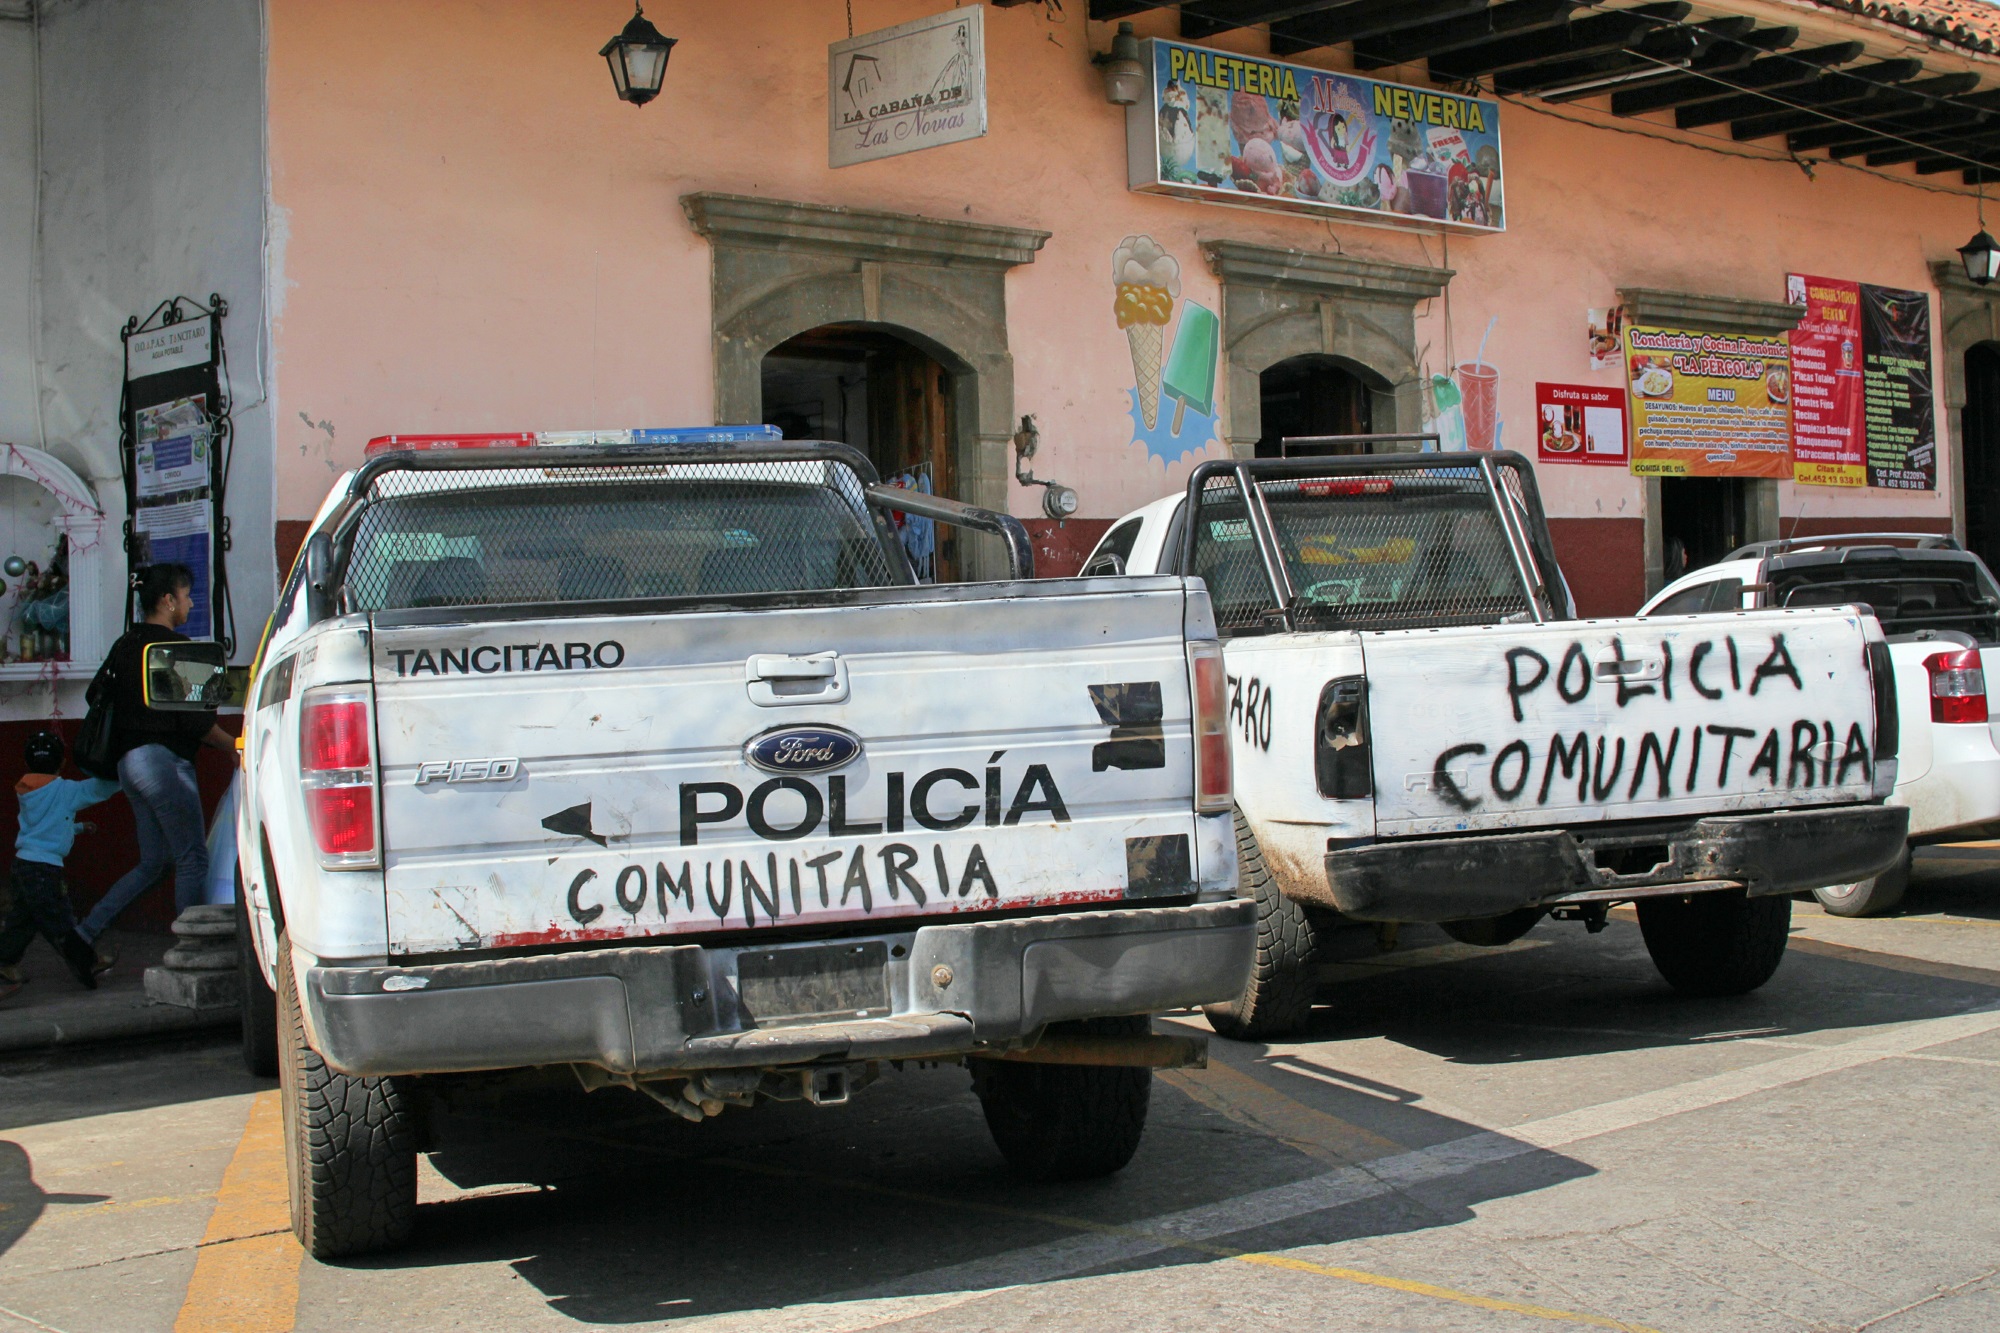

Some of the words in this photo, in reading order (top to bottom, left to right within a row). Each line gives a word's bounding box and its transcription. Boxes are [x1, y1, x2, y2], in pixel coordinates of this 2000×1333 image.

[1170, 47, 1300, 101] PALETERIA
[843, 110, 865, 124] LA
[869, 94, 934, 118] CABAÑA
[939, 85, 962, 102] DE
[1373, 84, 1486, 133] NEVERIA
[855, 117, 889, 149] Las
[894, 109, 965, 141] Novias
[1809, 287, 1857, 304] CONSULTORIO
[1822, 306, 1848, 322] DENTAL
[169, 326, 206, 344] TANCITARO
[1631, 331, 1692, 349] Lonchería
[1693, 338, 1701, 352] y
[1702, 336, 1737, 352] Cocina
[152, 351, 164, 359] AGUA
[164, 345, 183, 356] POTABLE
[1553, 389, 1580, 400] Disfruta
[1582, 392, 1589, 400] su
[1591, 391, 1609, 401] sabor
[1707, 388, 1736, 401] MENU
[1644, 402, 1678, 411] DESAYUNOS:
[1678, 405, 1697, 413] Huevos
[1670, 417, 1684, 425] carne
[1639, 427, 1663, 437] pechuga
[1635, 465, 1661, 473] COMIDA
[1661, 465, 1674, 473] DEL
[1816, 465, 1835, 473] Citas
[387, 640, 625, 677] TANCITARO
[1505, 632, 1803, 722] POLICIA
[774, 736, 835, 764] Ford
[1432, 719, 1872, 811] COMUNITARIA
[679, 750, 1072, 846] POLICÍA
[567, 843, 999, 928] COMUNITARIA
